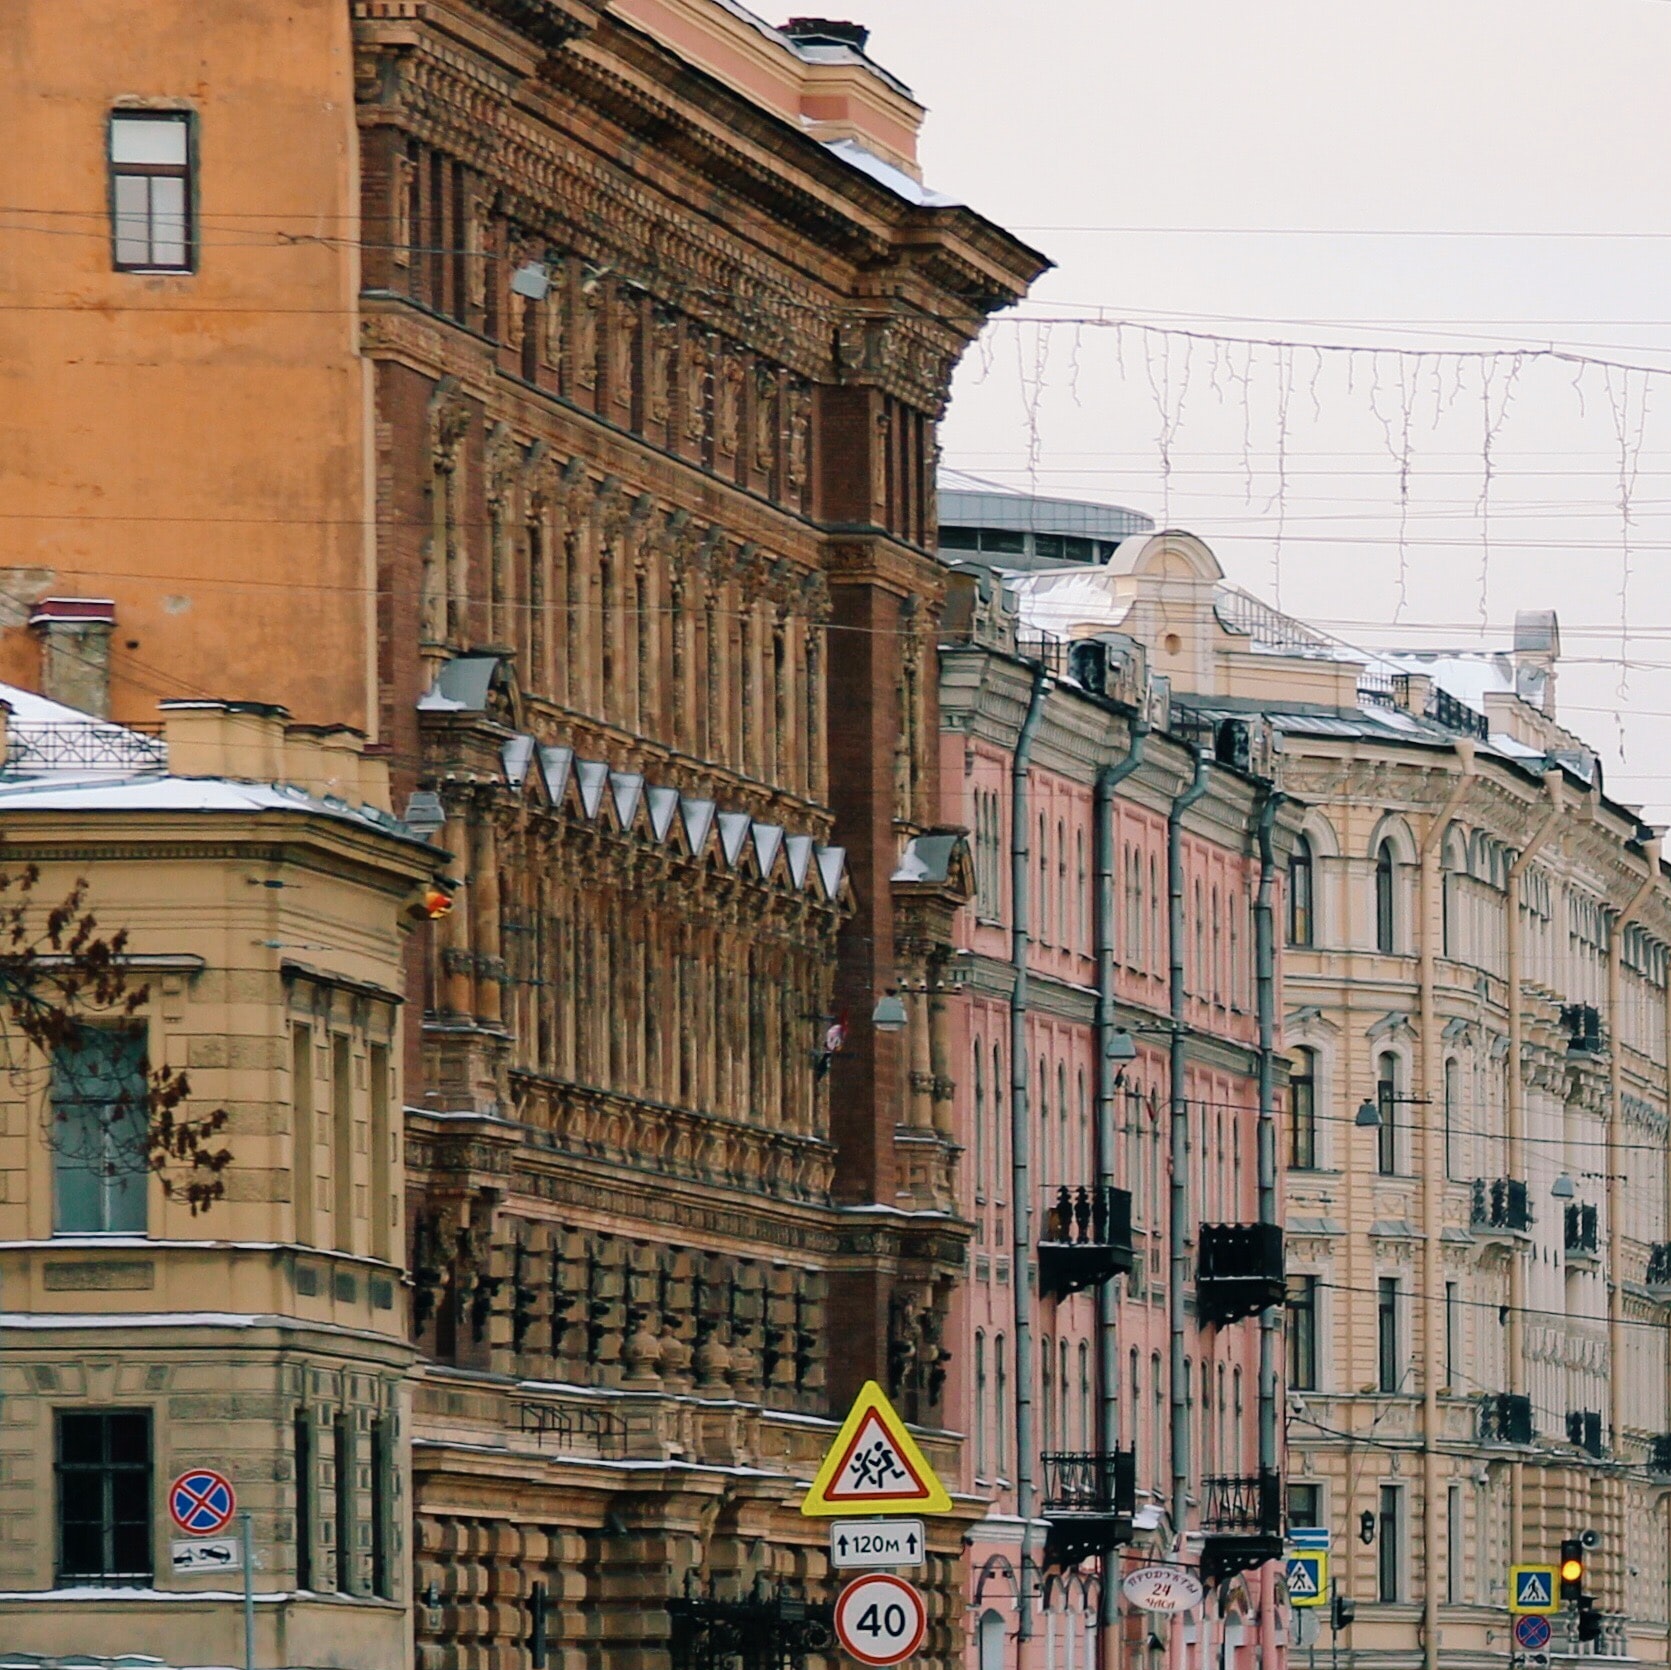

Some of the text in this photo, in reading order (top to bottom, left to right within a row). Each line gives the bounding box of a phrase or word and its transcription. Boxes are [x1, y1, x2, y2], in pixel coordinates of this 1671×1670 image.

[1127, 1570, 1199, 1594] ПРОДУКТЫ
[1152, 1582, 1171, 1597] 24
[1145, 1597, 1175, 1609] ЧАСА
[856, 1603, 906, 1637] 40
